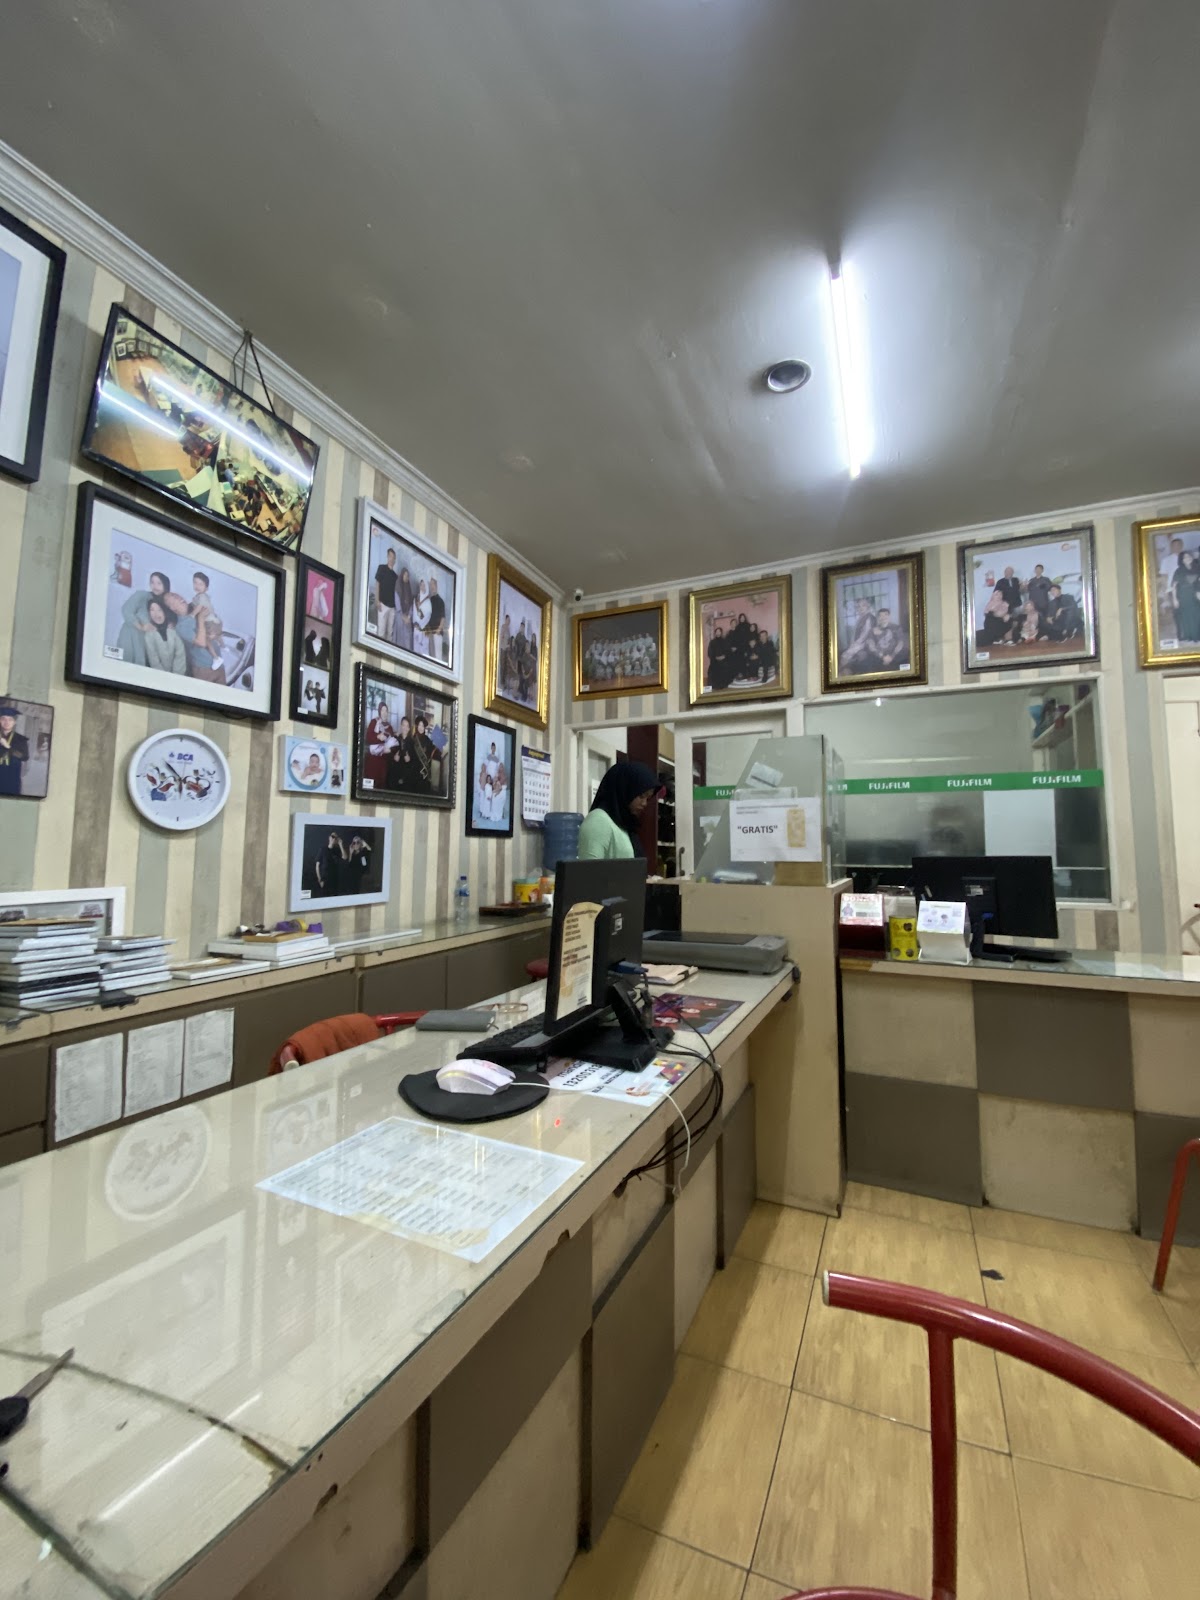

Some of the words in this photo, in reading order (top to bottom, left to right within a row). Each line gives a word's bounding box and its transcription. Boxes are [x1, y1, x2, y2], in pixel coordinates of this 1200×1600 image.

[177, 753, 193, 761] BCA
[947, 778, 992, 788] FUJIFILM
[1032, 774, 1082, 784] FUJIFILM
[869, 781, 910, 790] FUJIFILM
[737, 825, 778, 834] "GRATIS"
